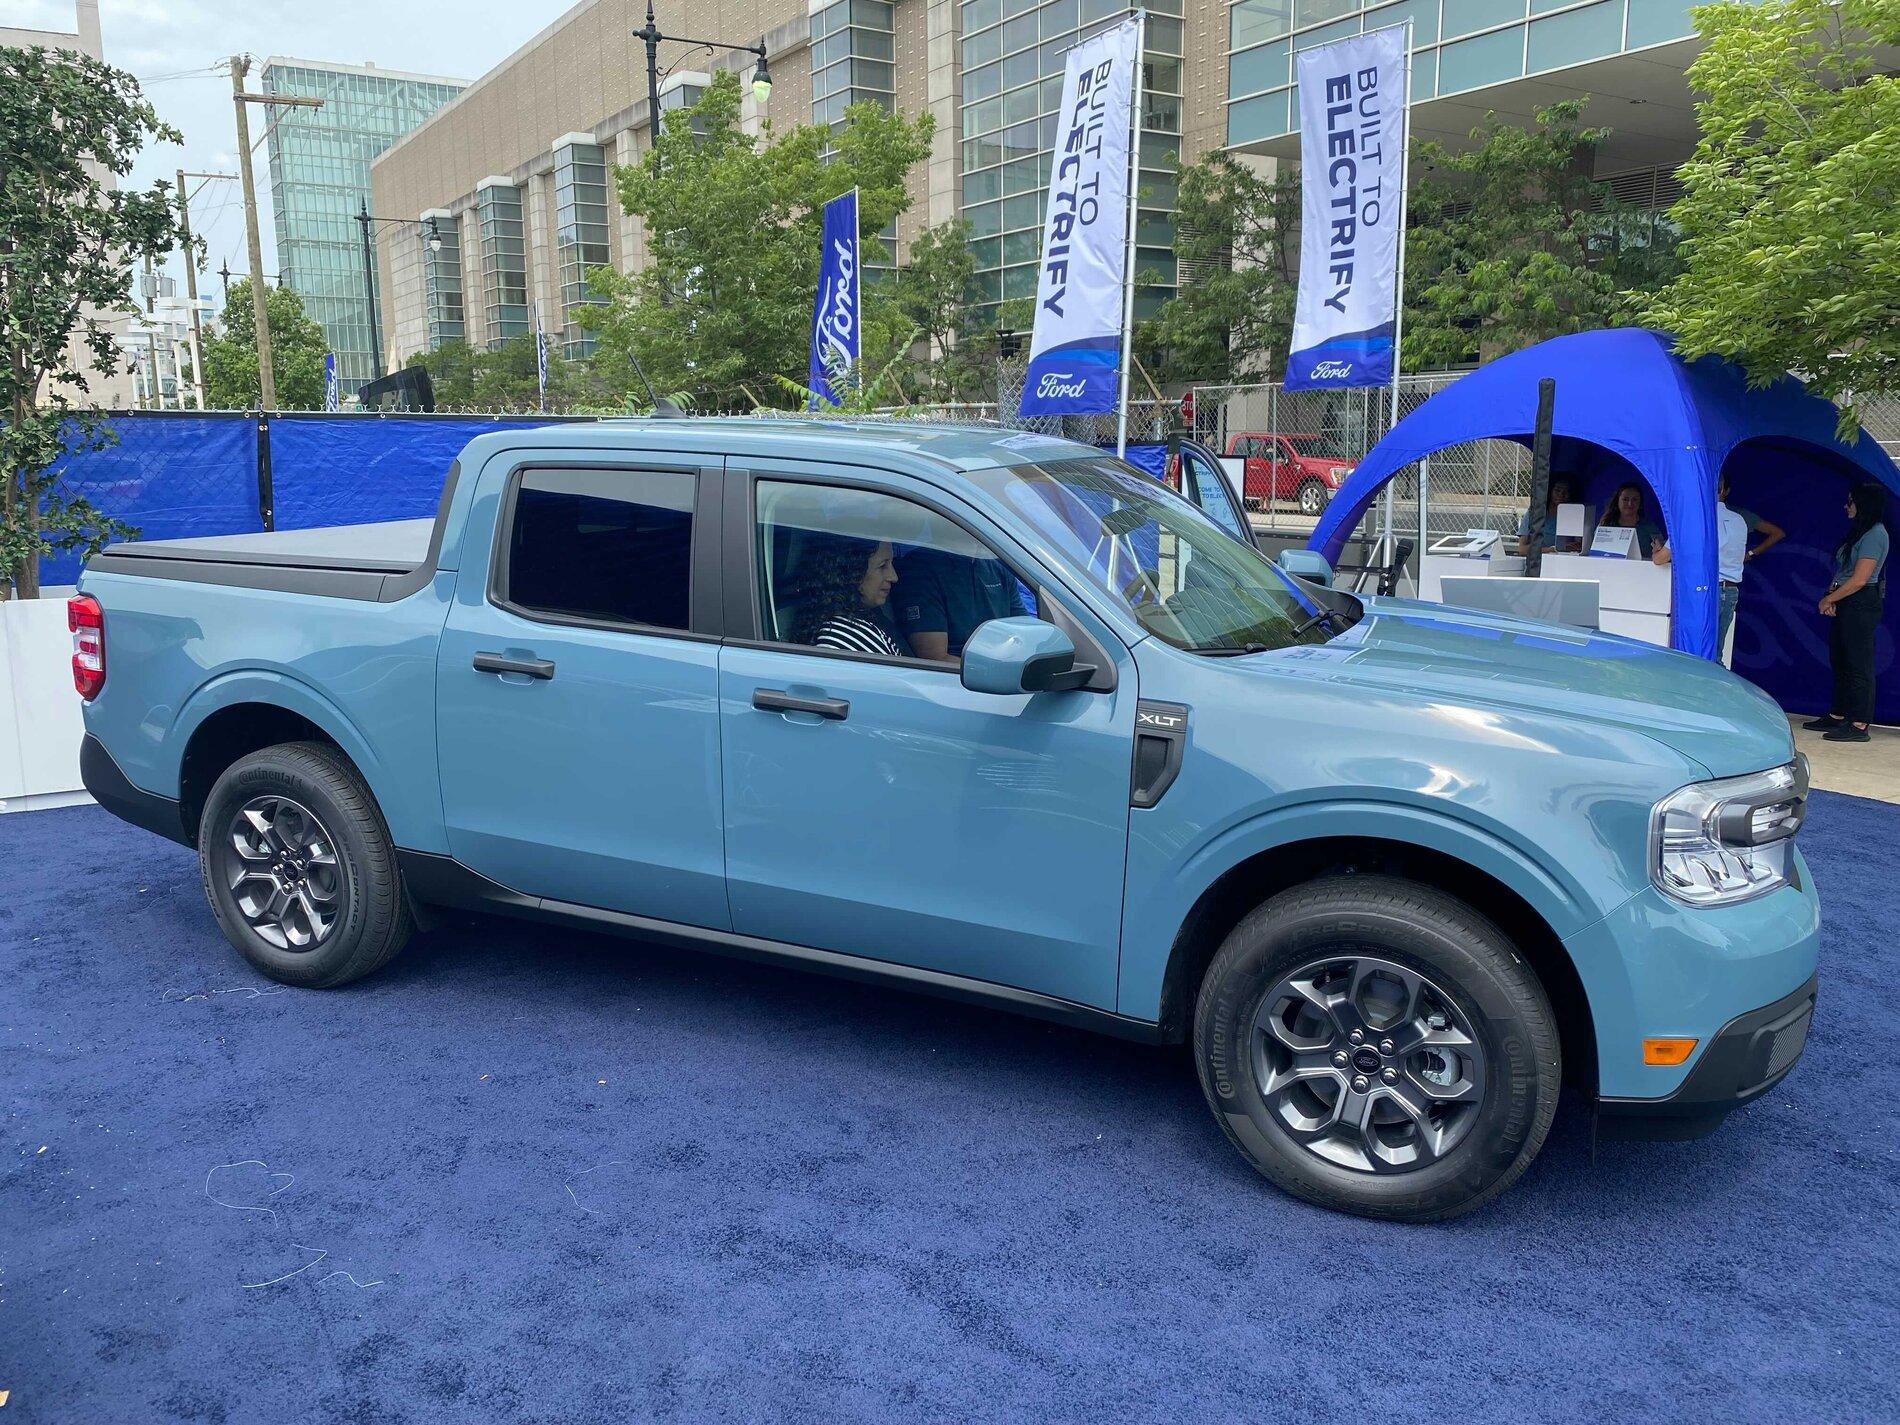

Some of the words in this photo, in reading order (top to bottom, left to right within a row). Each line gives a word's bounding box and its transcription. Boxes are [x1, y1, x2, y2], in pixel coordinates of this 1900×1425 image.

[1085, 59, 1112, 159] BUILT
[1357, 66, 1382, 165] BUILT
[1043, 68, 1094, 318] ELECTRIFY
[1079, 171, 1099, 226] TO
[1324, 73, 1356, 314] ELECTRIFY
[1362, 175, 1381, 227] TO
[815, 238, 854, 377] Ford
[1037, 373, 1087, 398] Ford
[1310, 360, 1352, 379] Ford
[1182, 401, 1194, 410] STO
[1138, 713, 1182, 727] XLT
[239, 767, 296, 785] Continental
[1210, 998, 1235, 1099] Continental
